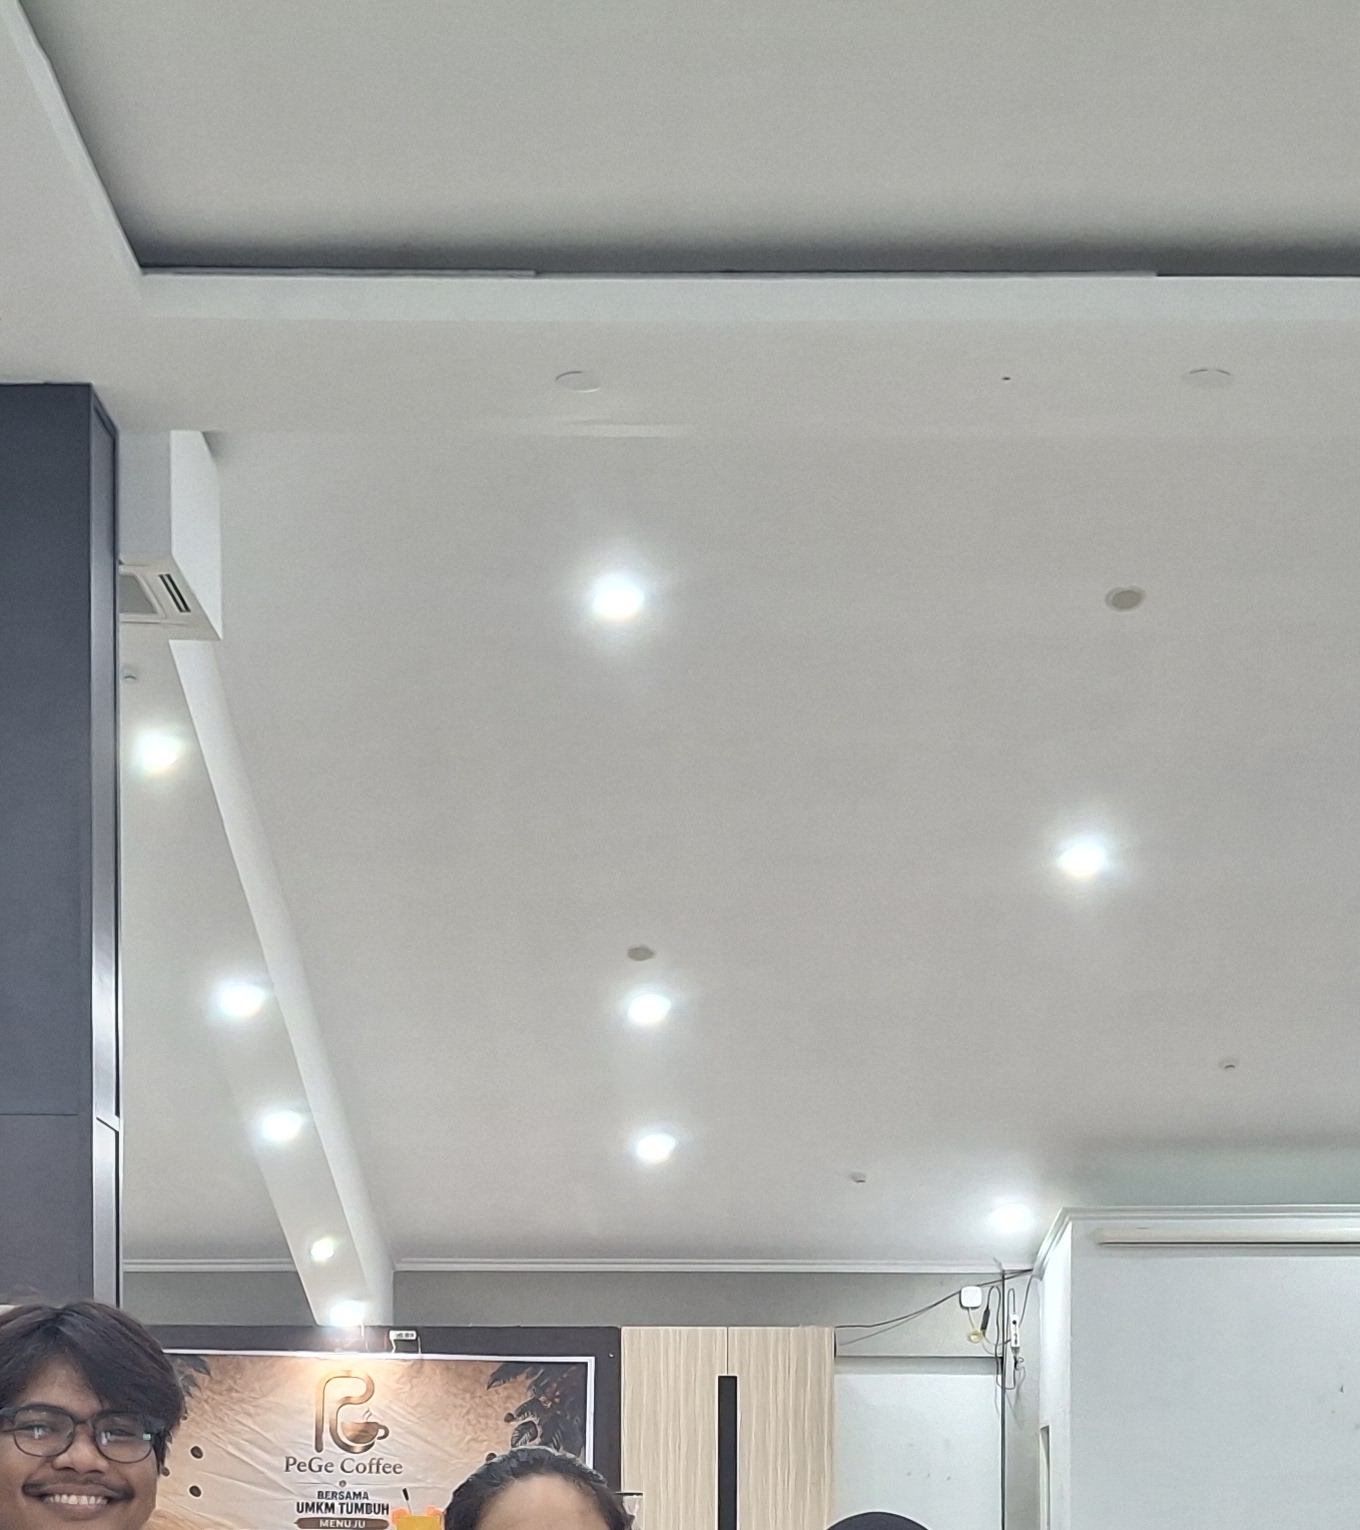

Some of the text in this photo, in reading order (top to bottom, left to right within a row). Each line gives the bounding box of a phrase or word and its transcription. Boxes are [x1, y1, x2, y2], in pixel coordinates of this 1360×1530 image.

[284, 1456, 403, 1474] PeGe Coffee
[317, 1490, 369, 1500] BERSAMA
[296, 1502, 390, 1515] UMKM TUMBUH
[319, 1519, 366, 1528] MENUJU
